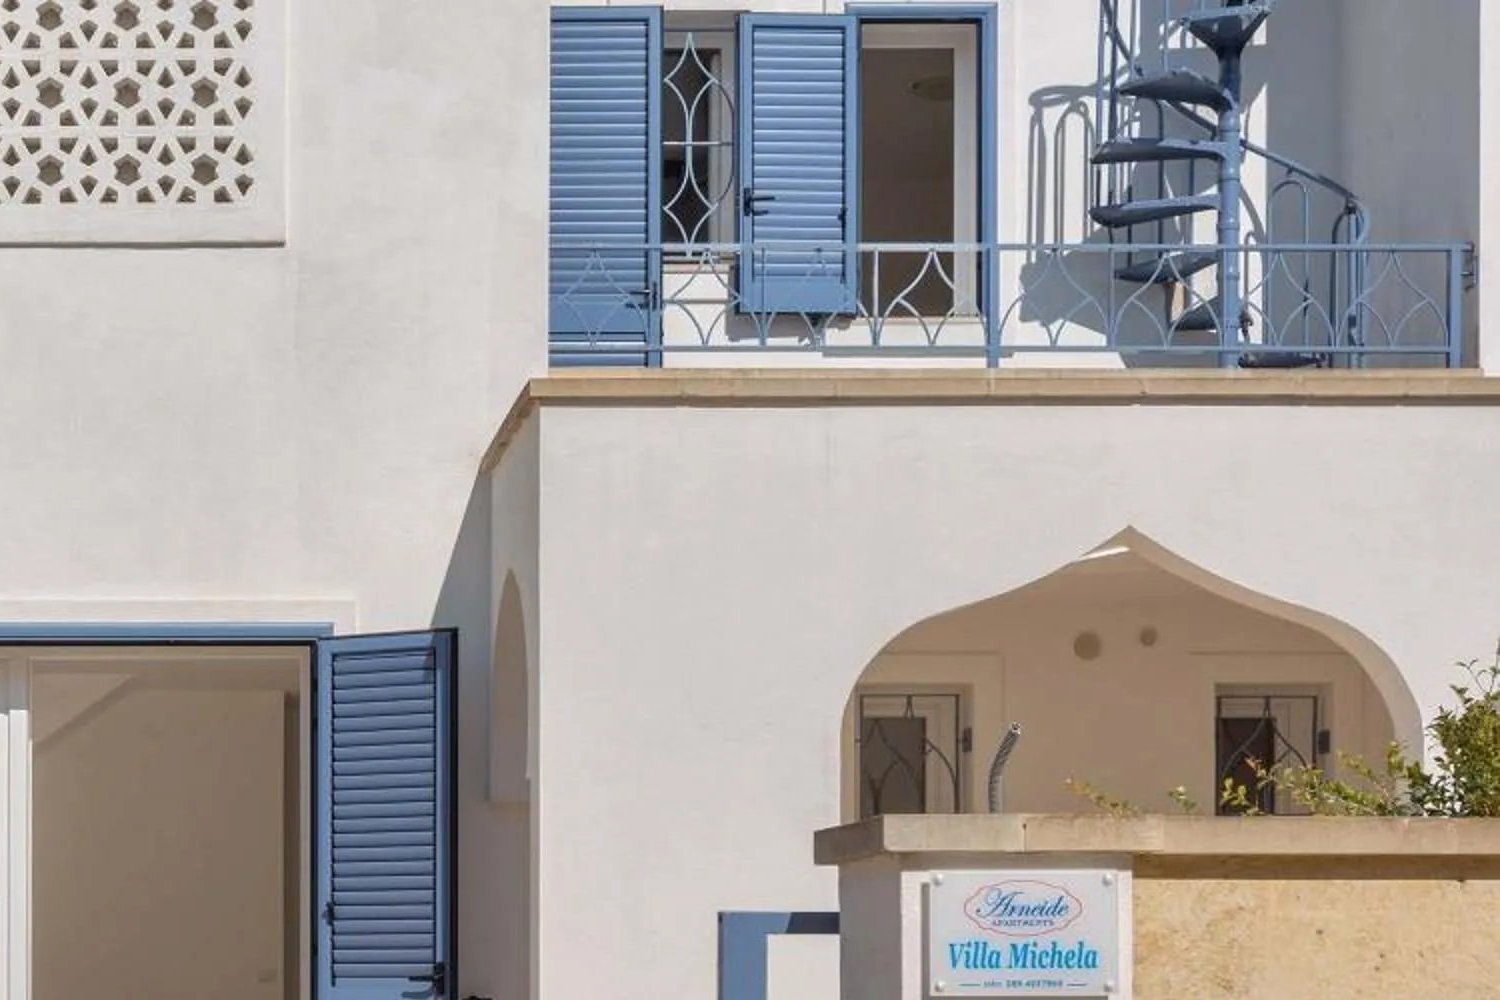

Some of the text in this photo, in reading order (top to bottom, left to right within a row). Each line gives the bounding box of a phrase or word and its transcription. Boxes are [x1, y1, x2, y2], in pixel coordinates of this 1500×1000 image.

[976, 888, 1069, 918] Arneide
[949, 940, 1099, 970] Villa Michela
